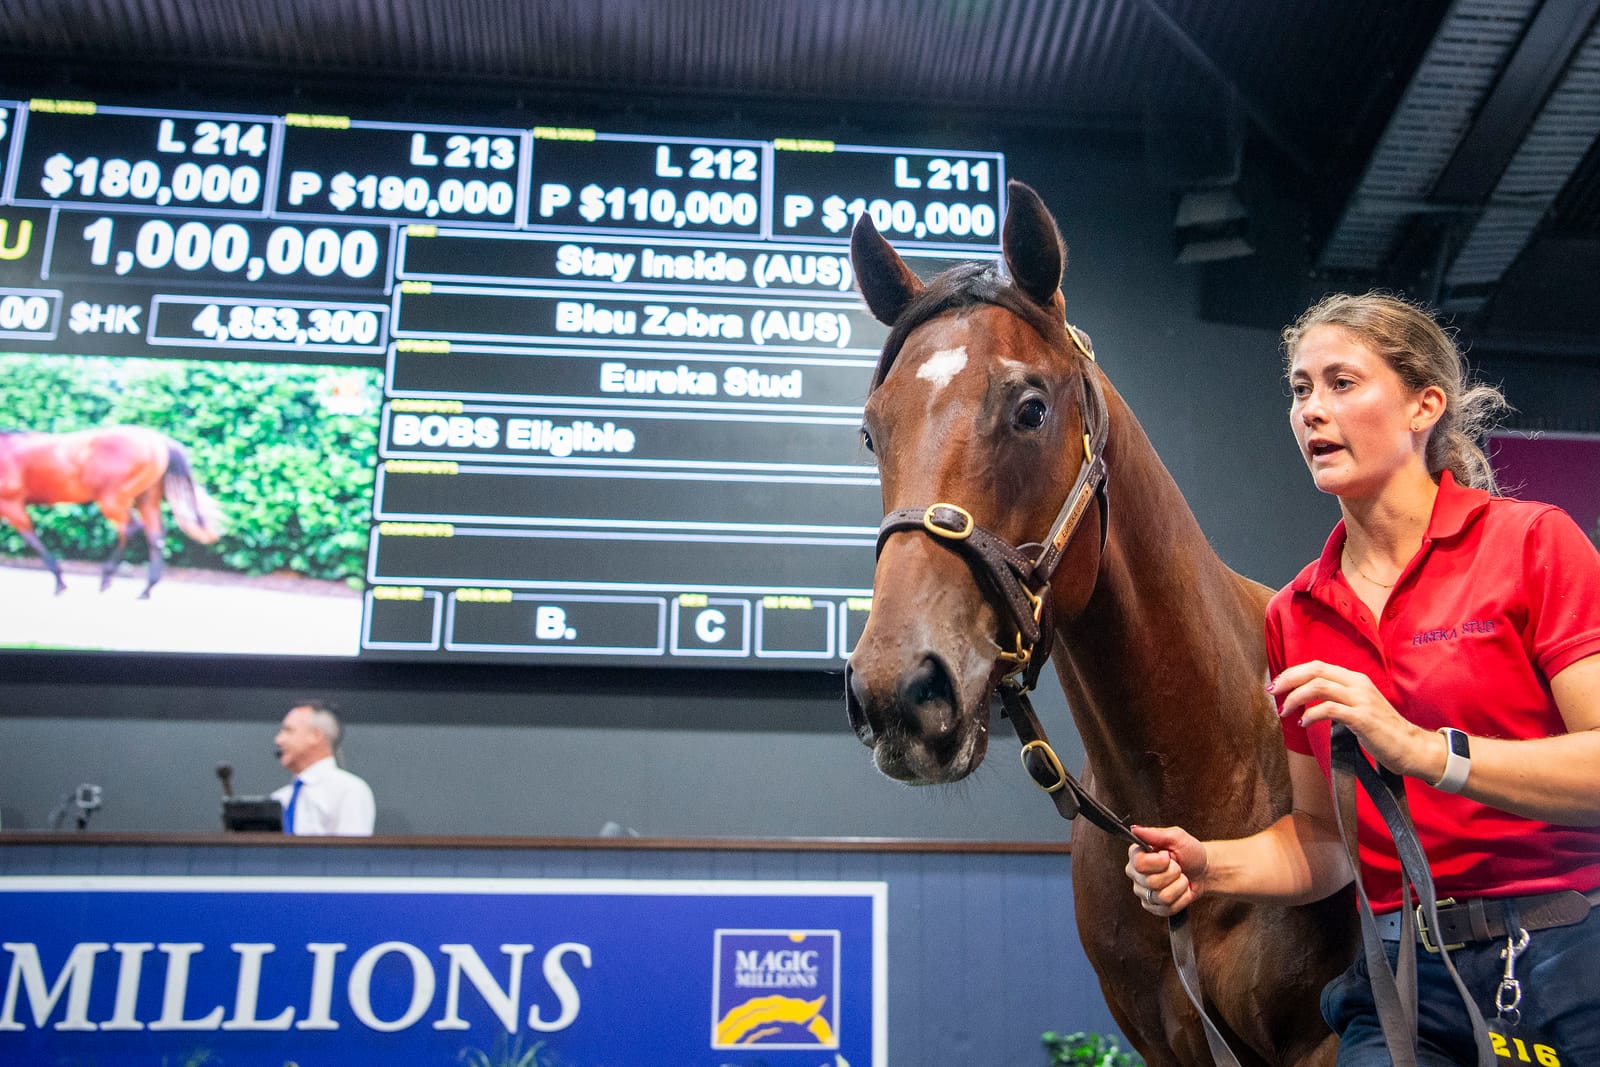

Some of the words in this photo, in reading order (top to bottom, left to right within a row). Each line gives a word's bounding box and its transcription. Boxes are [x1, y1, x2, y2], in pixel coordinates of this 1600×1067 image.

[158, 119, 186, 153] L
[193, 122, 266, 157] 214
[411, 133, 438, 166] L
[445, 136, 515, 169] 213
[41, 154, 261, 206] $180,000
[657, 145, 683, 177] L
[689, 147, 758, 181] 212
[895, 157, 922, 188] L
[927, 159, 990, 192] 211
[289, 171, 322, 205] P
[329, 172, 513, 217] $190,000
[540, 184, 572, 217] P
[579, 184, 758, 228] $110,000
[784, 195, 814, 228] P
[83, 217, 379, 281] 1,000,000
[556, 244, 635, 283] Stay
[641, 248, 747, 282] Inside
[753, 253, 852, 291] (AUS)
[68, 301, 142, 335] $HK
[192, 304, 379, 346] 4,853,300
[556, 302, 636, 335] Bleu
[642, 305, 744, 339] Zebra
[750, 310, 851, 348] (AUS)
[600, 362, 717, 396] Eureka
[723, 366, 803, 398] Stud
[392, 414, 500, 449] BOBS
[506, 418, 636, 457] Eligible
[535, 605, 577, 641] B.
[695, 608, 727, 644] C
[1412, 629, 1457, 646] EUREKA
[1462, 620, 1495, 635] STUD
[735, 949, 819, 971] MAGIC
[0, 942, 592, 1033] MILLIONS
[735, 971, 818, 988] MILLIONS
[1488, 1031, 1561, 1067] 216
